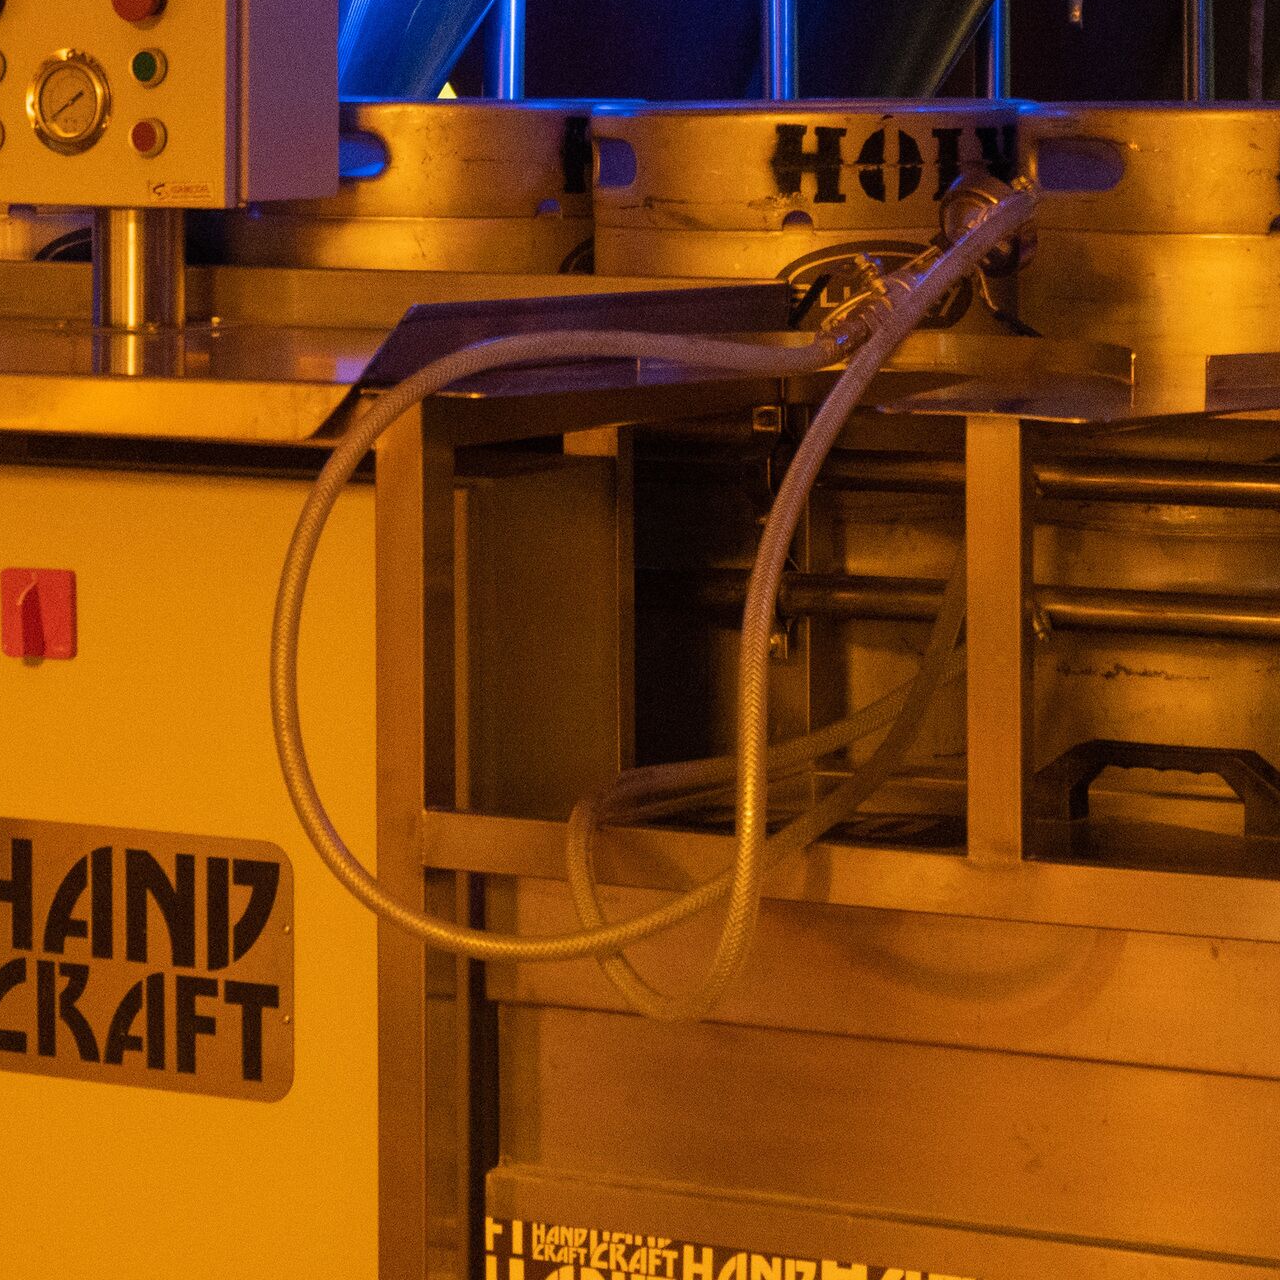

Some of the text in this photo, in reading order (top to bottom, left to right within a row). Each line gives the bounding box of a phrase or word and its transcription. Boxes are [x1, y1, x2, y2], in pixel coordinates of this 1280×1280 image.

[532, 1223, 588, 1253] HAND
[533, 1245, 588, 1266] CRAFT
[590, 1242, 679, 1276] CRAFT
